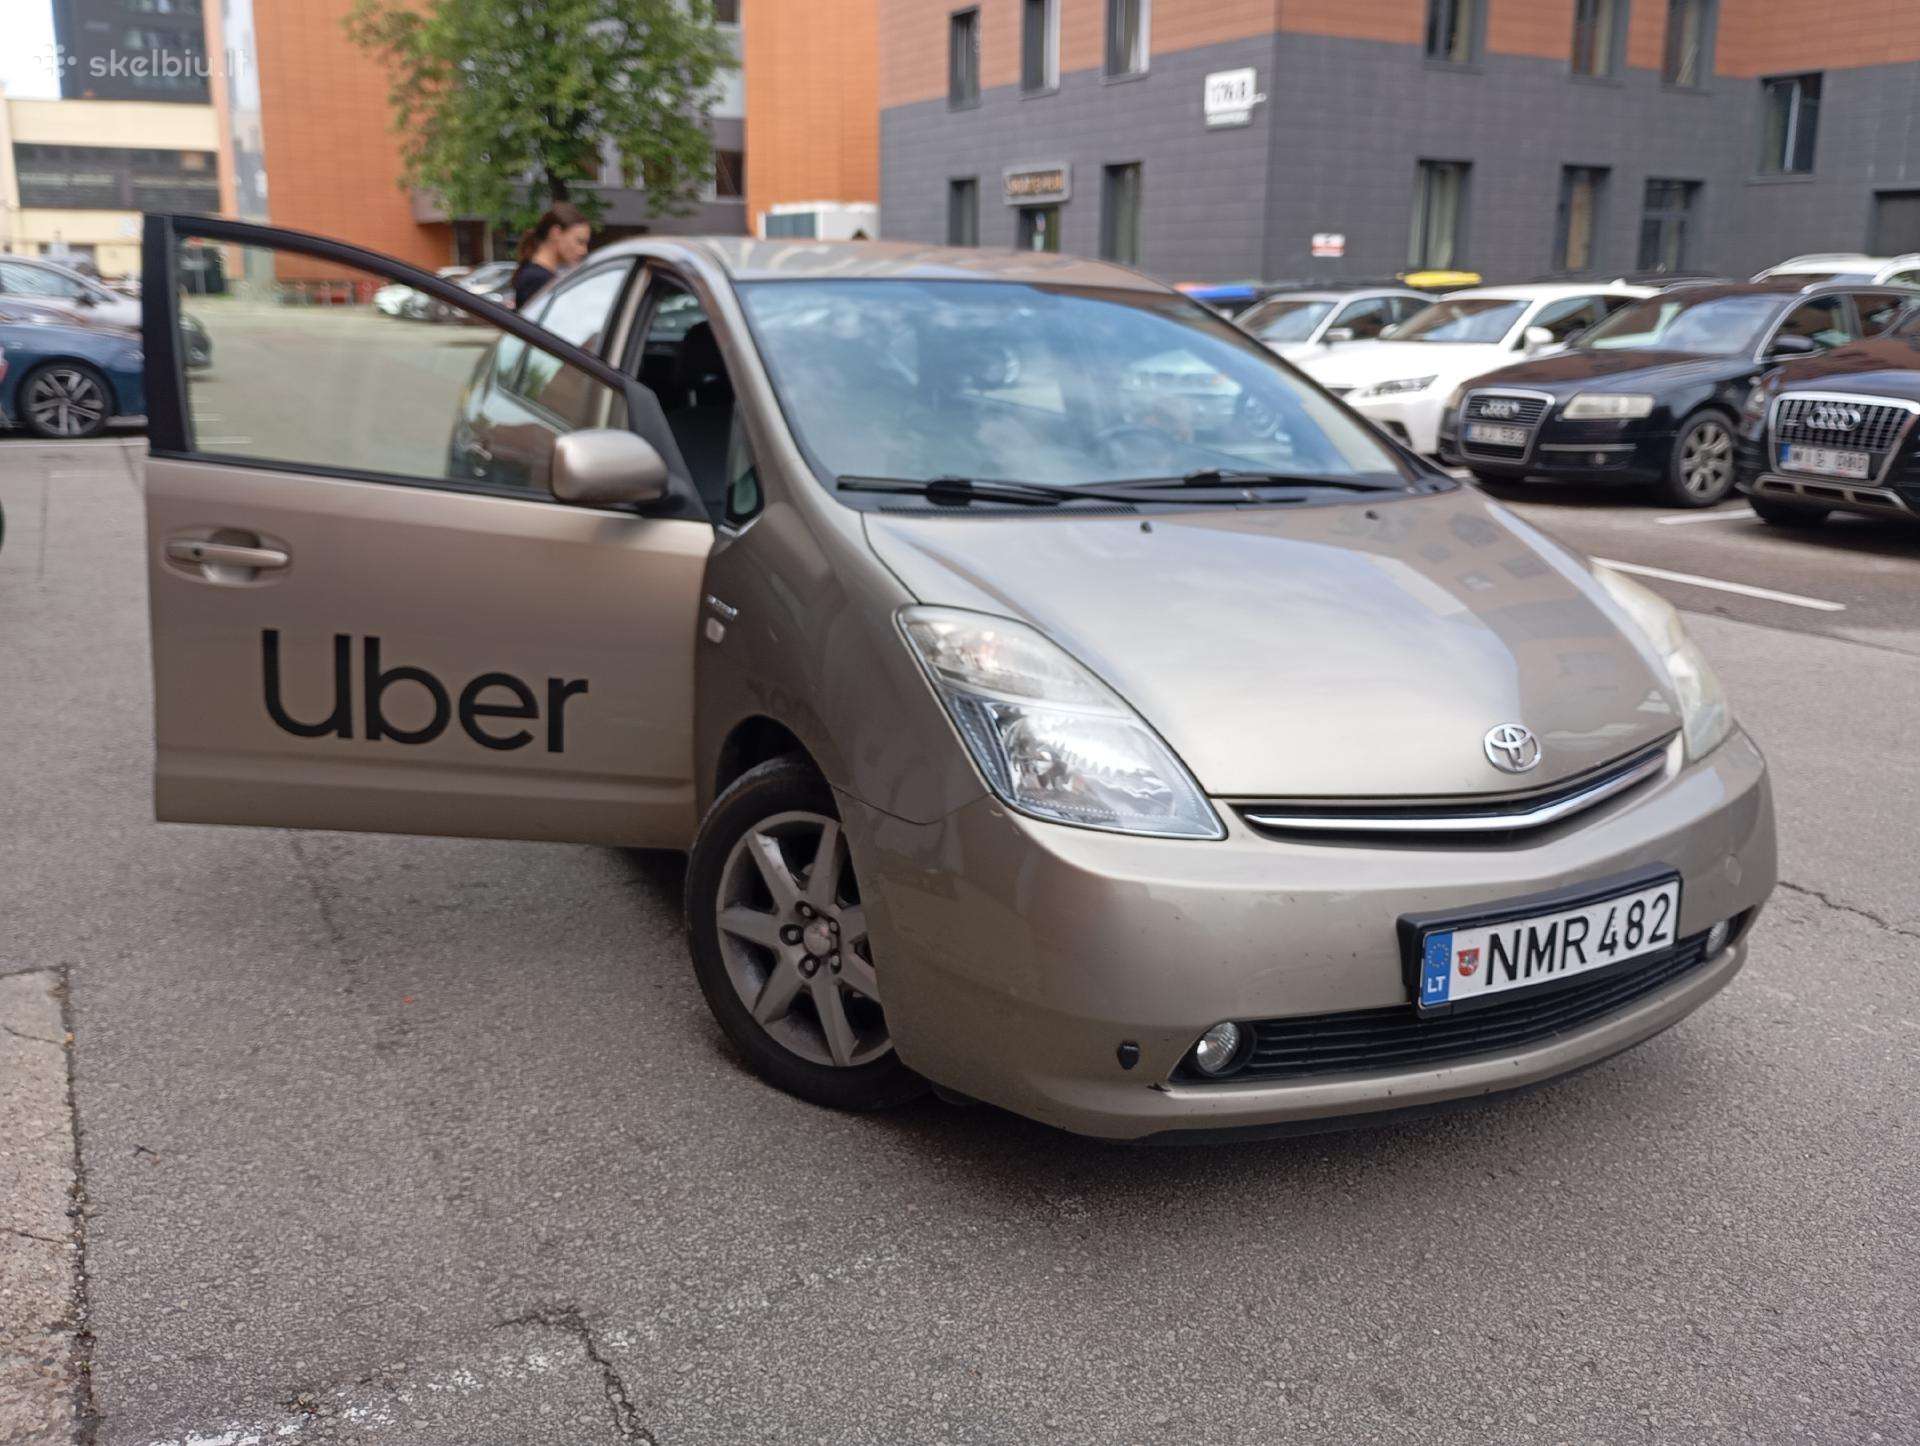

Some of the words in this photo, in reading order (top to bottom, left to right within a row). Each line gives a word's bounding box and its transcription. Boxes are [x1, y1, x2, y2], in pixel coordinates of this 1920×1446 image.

[261, 628, 589, 753] Uber
[1426, 975, 1445, 994] LT
[1485, 915, 1590, 986] NMR
[1597, 892, 1671, 957] 482
